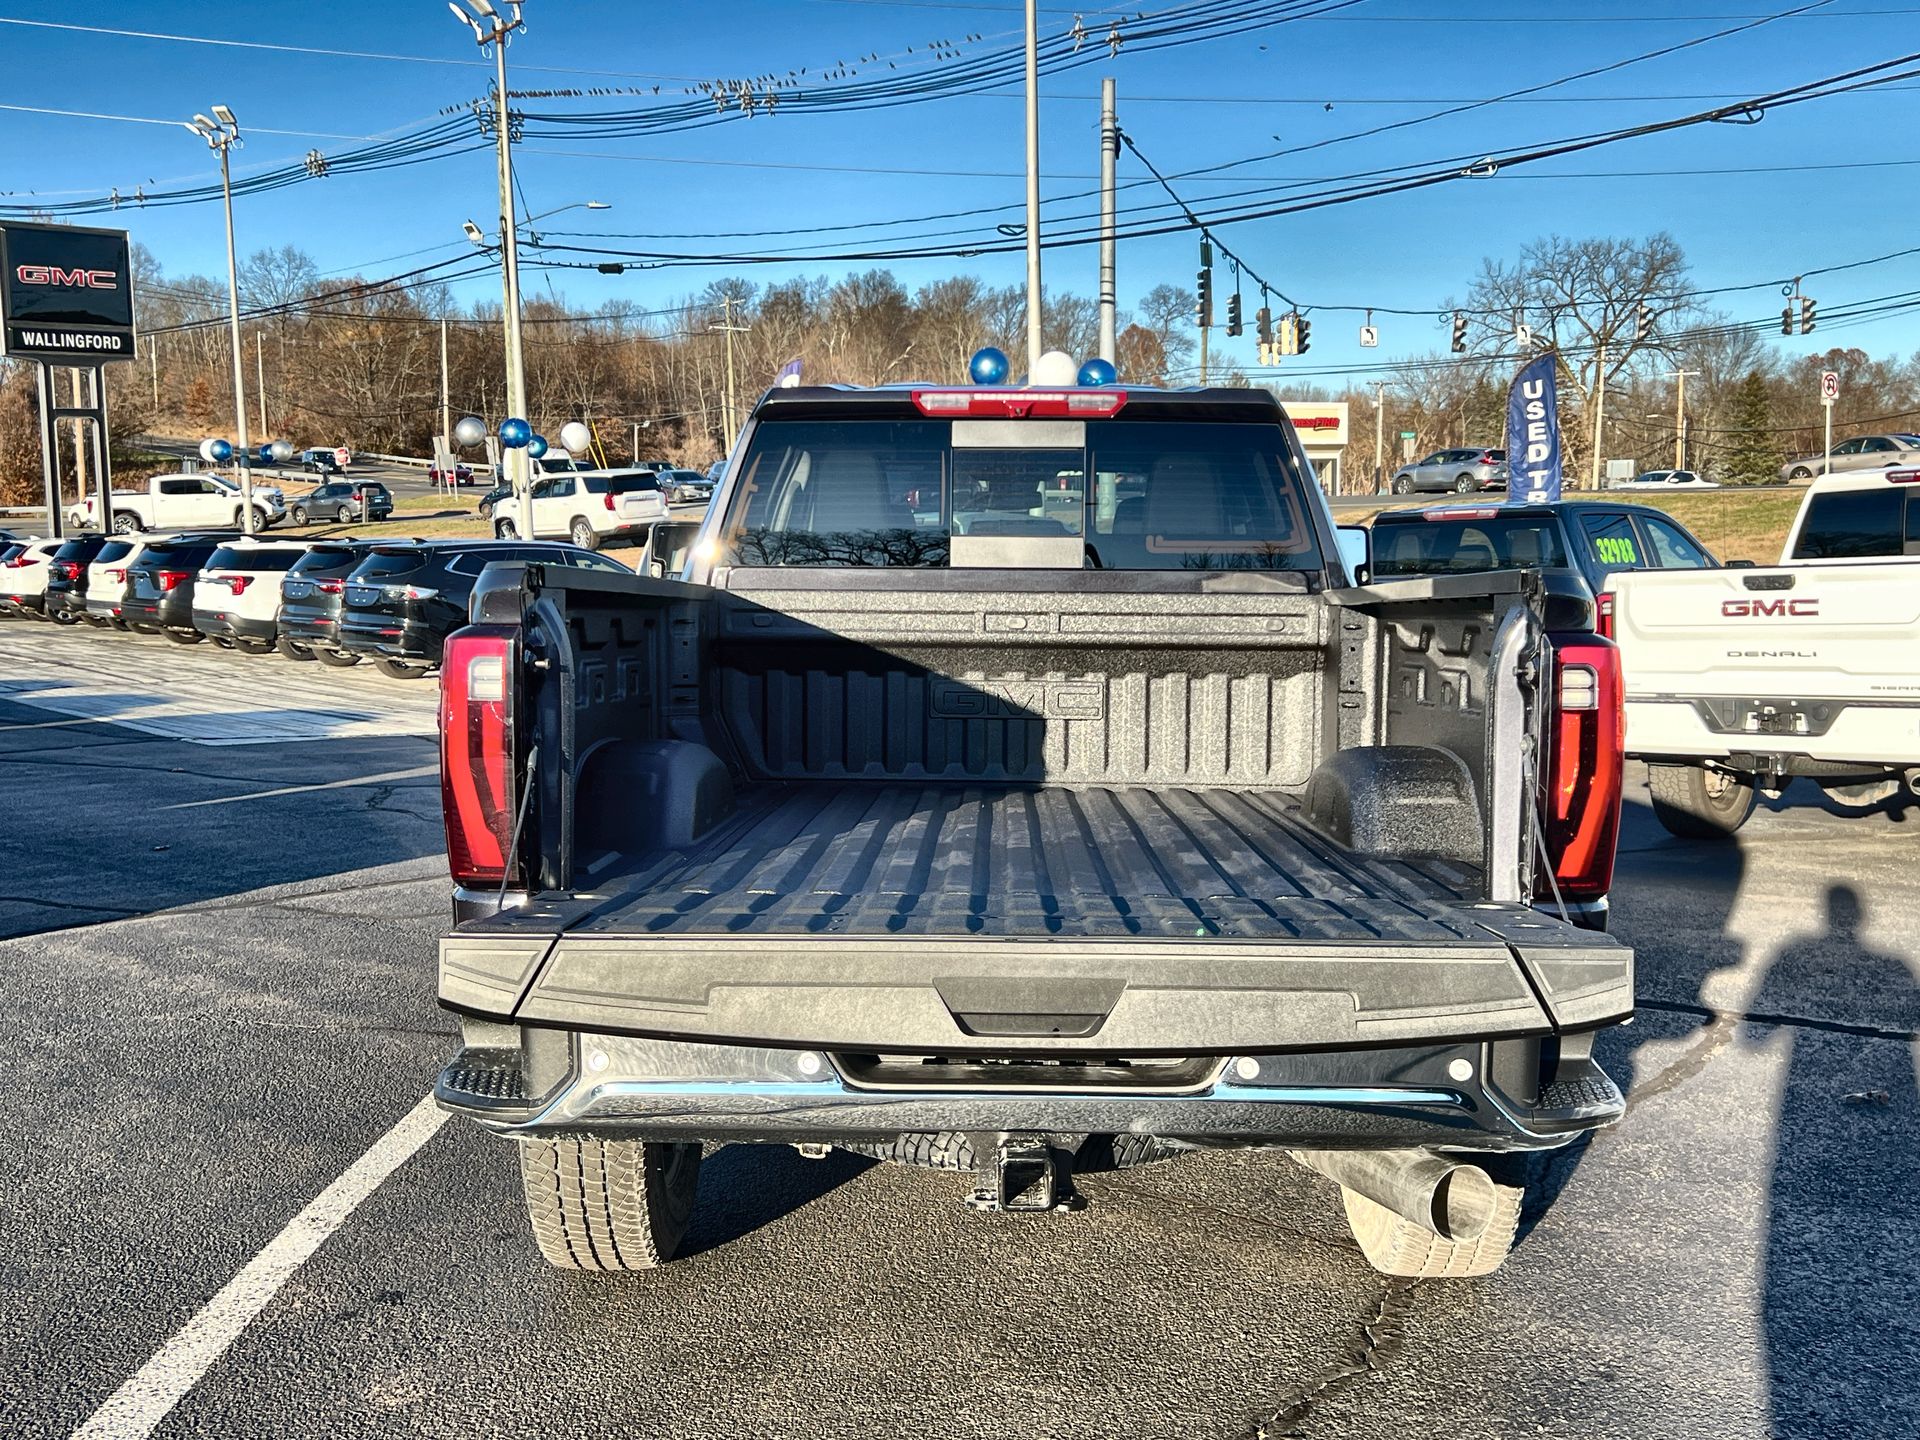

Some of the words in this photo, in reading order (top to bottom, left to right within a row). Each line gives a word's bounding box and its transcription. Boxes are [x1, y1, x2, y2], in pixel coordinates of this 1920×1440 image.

[16, 265, 117, 289] GMC
[22, 331, 121, 350] WALLINGFORD
[1522, 379, 1549, 464] USED
[1596, 537, 1636, 564] 32988
[1721, 599, 1819, 617] GMC
[933, 684, 1101, 716] GMC
